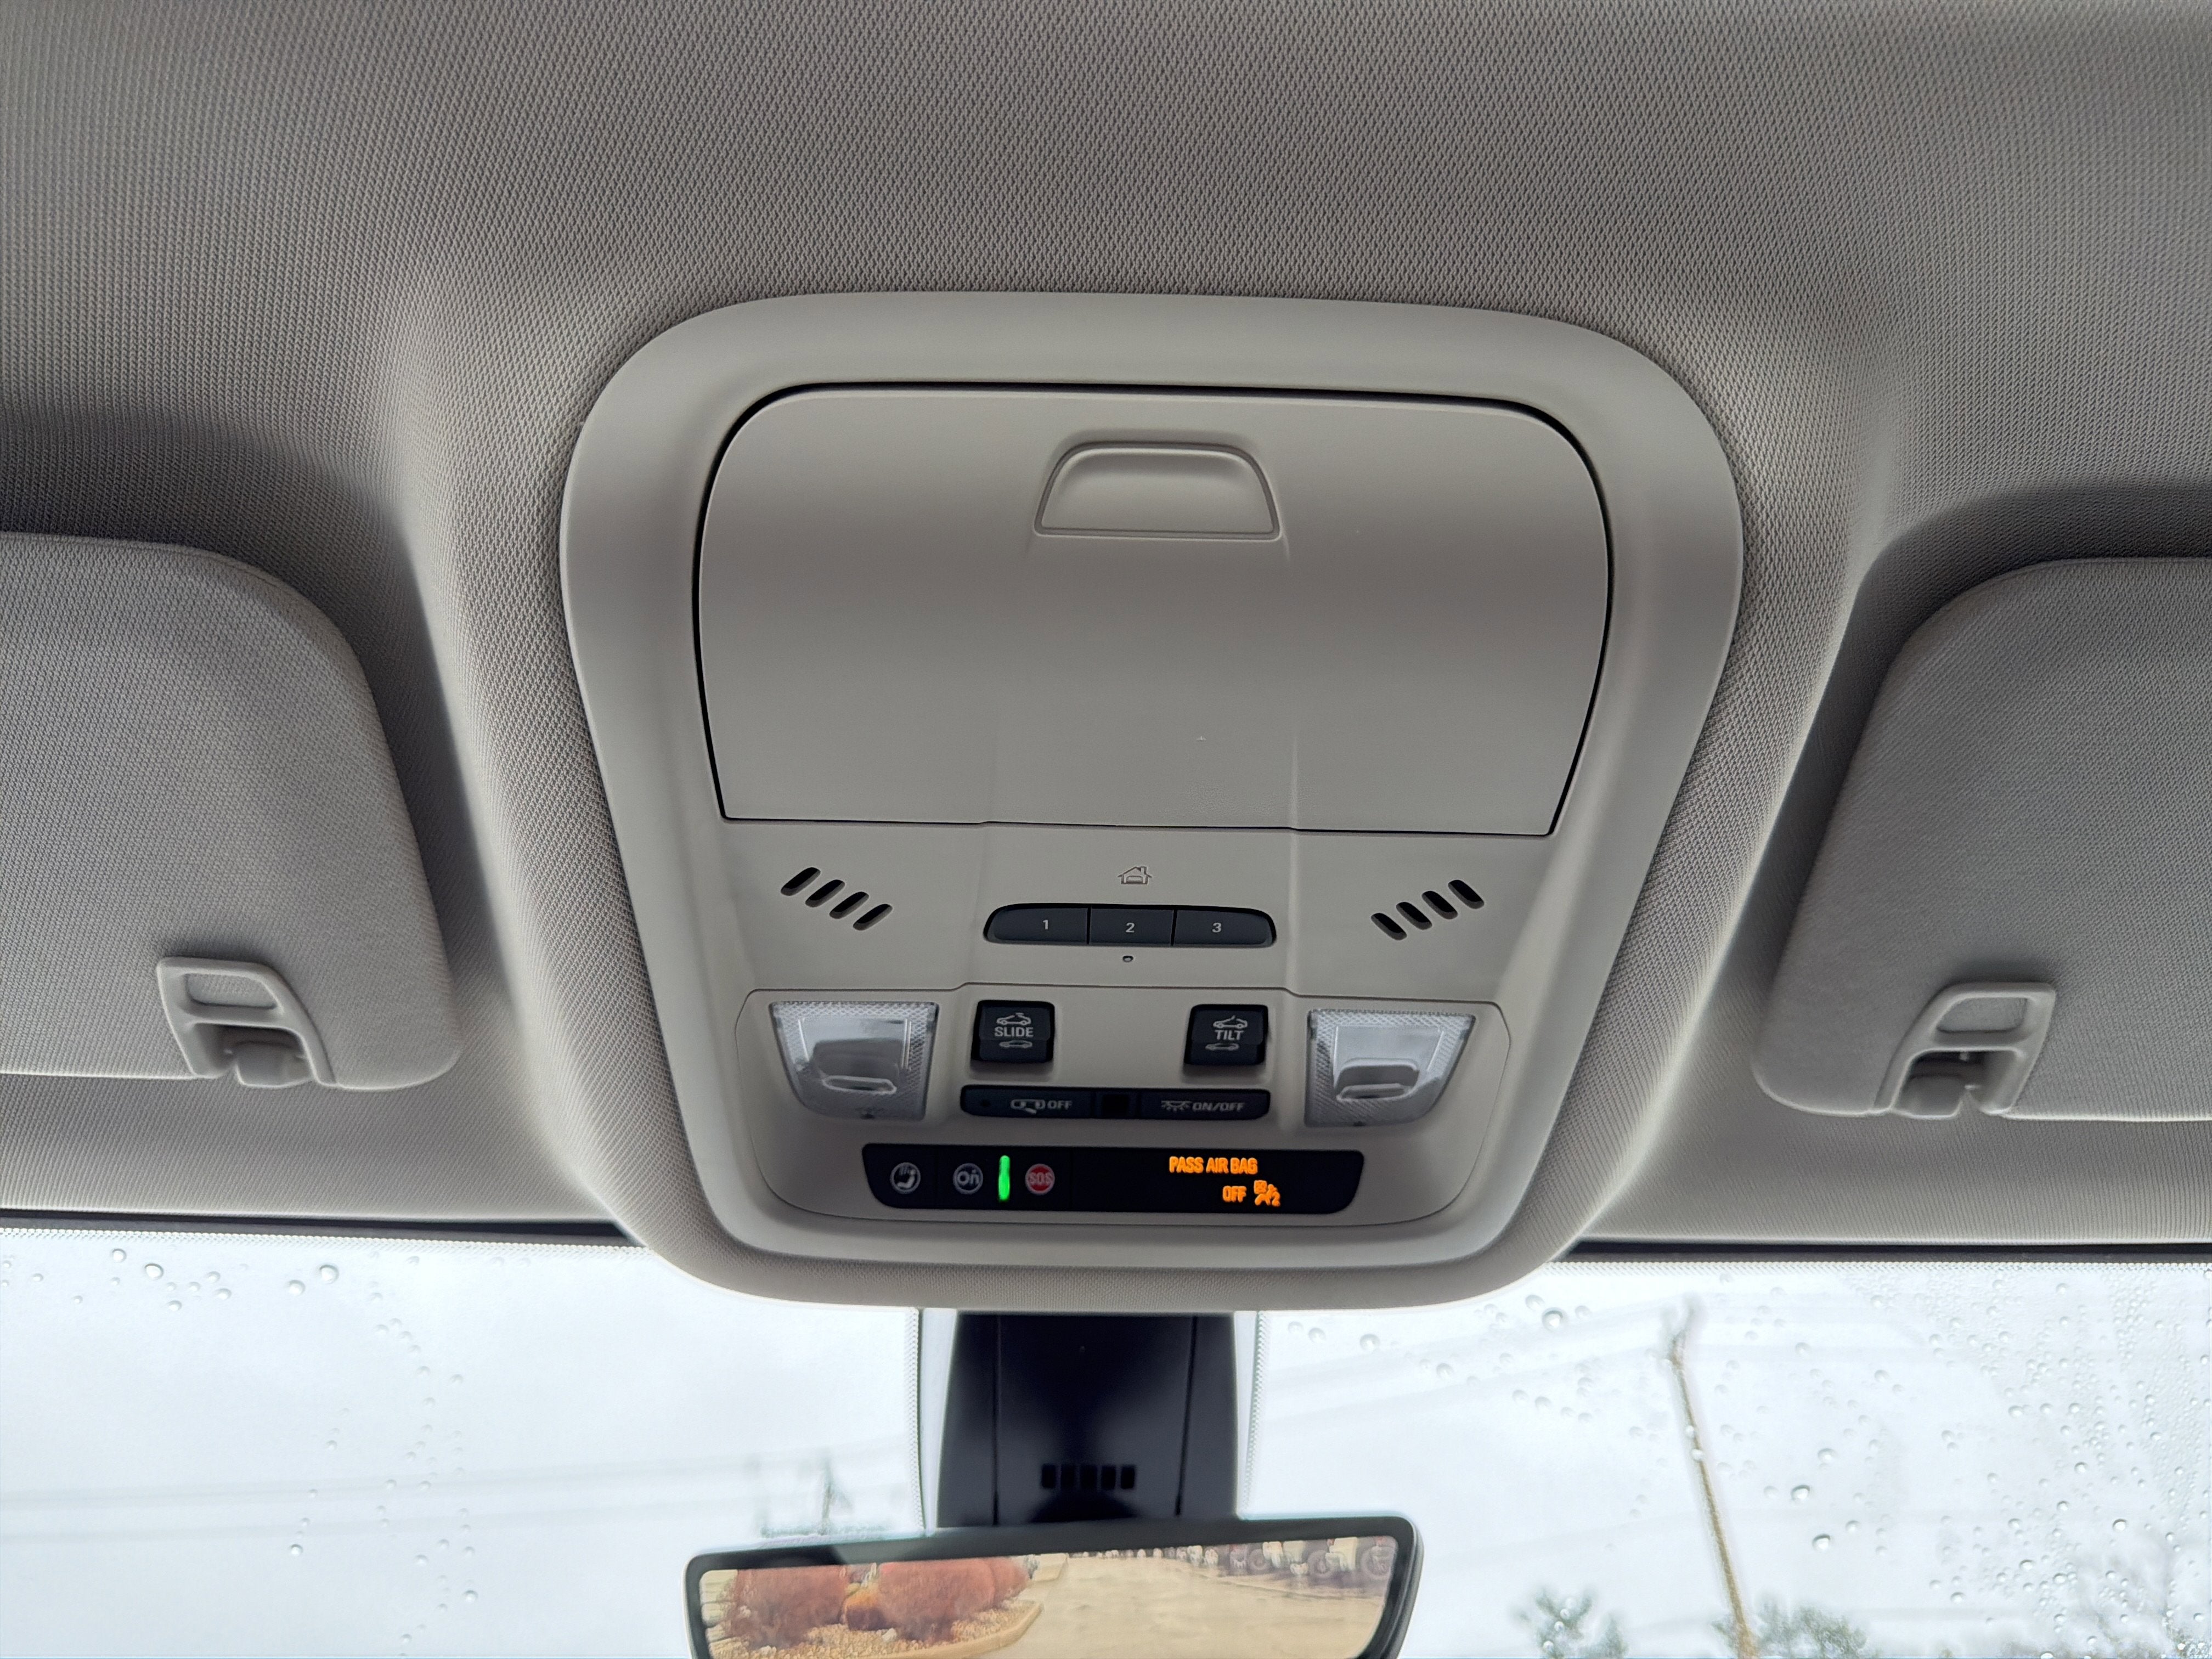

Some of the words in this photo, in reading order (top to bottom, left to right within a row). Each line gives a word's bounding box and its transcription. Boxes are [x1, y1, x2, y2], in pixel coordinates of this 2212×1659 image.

[1042, 919, 1049, 930] 1
[1125, 922, 1135, 933] 2
[1212, 922, 1222, 933] 3
[994, 1026, 1034, 1037] SLIDE
[1215, 1030, 1244, 1040] TILT
[1047, 1101, 1072, 1109] OFF
[1192, 1102, 1245, 1111] ON/OFF
[1169, 1156, 1204, 1173] PASS
[1206, 1158, 1229, 1173] AIR
[1230, 1158, 1258, 1175] BAG
[1027, 1172, 1052, 1186] SOS
[1222, 1186, 1247, 1203] OFF
